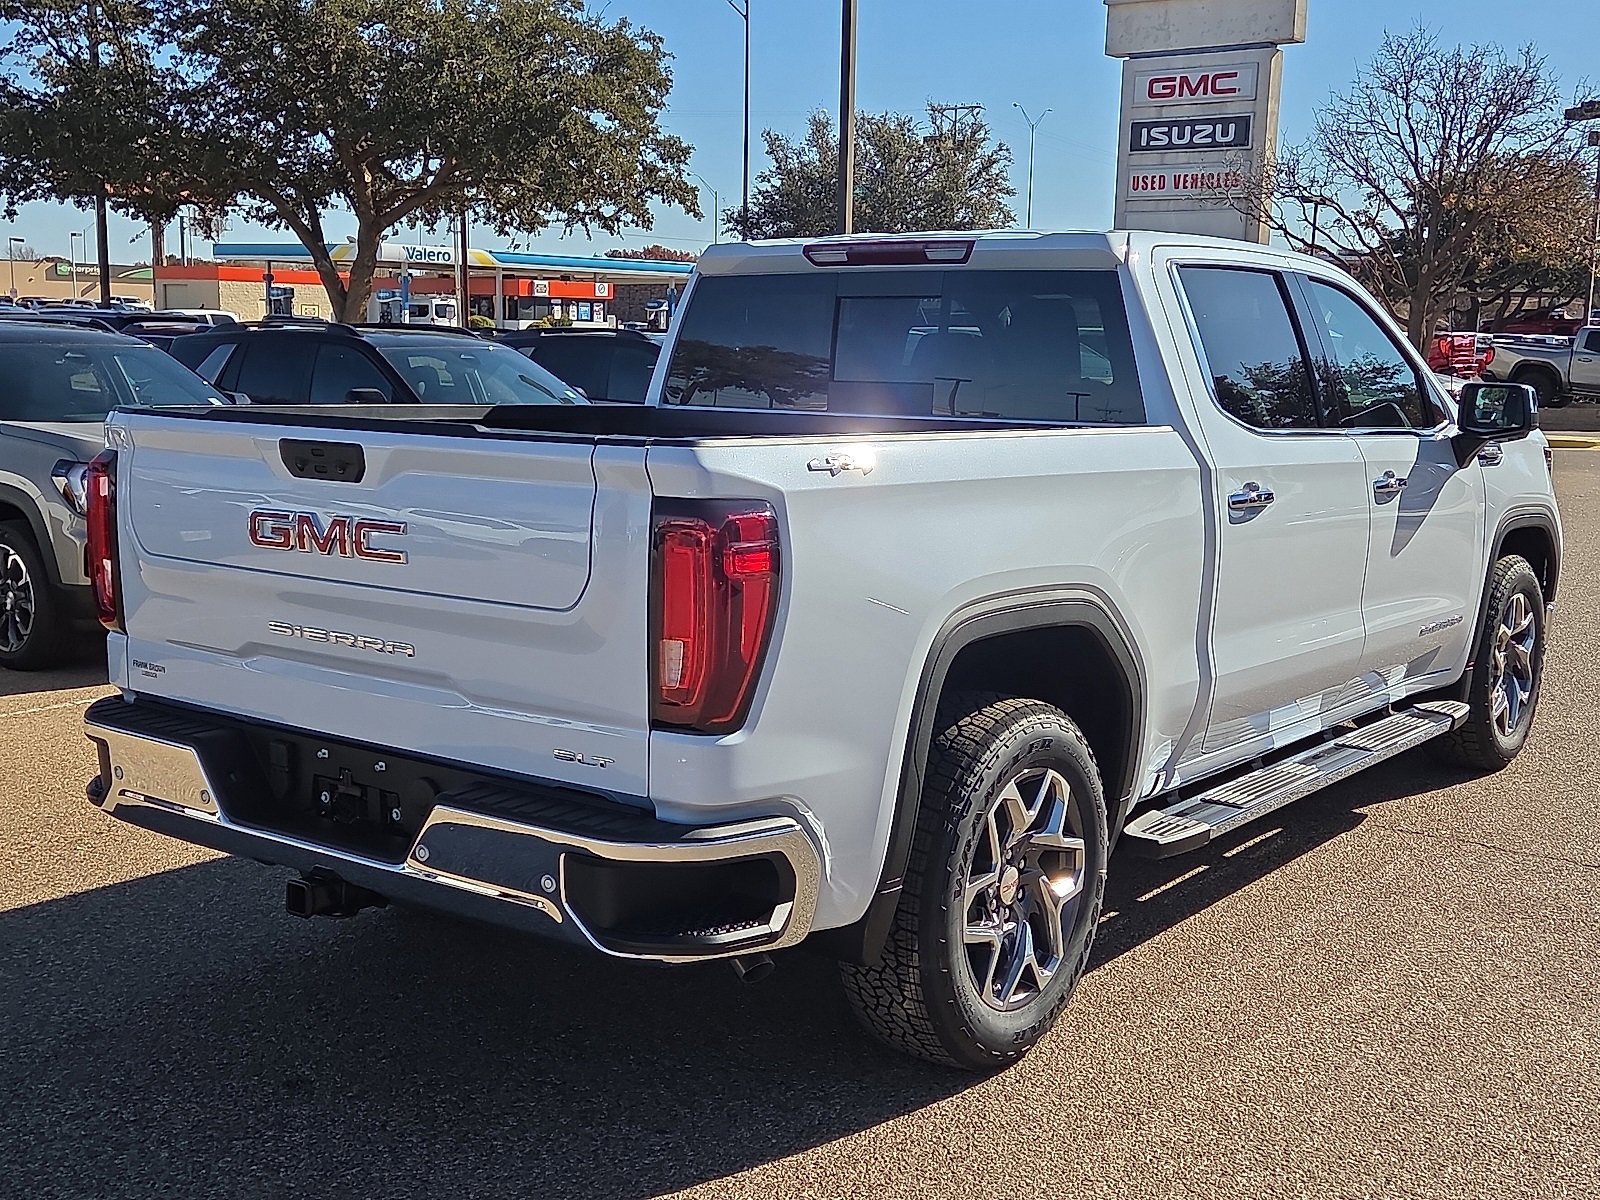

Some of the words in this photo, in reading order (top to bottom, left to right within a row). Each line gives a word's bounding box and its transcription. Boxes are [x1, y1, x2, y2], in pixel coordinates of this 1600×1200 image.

[1140, 122, 1236, 147] ISUZU
[1131, 174, 1166, 192] USED
[404, 246, 451, 262] Valero
[248, 507, 409, 565] GMC
[268, 620, 416, 658] SIERRA
[553, 748, 616, 769] SLT
